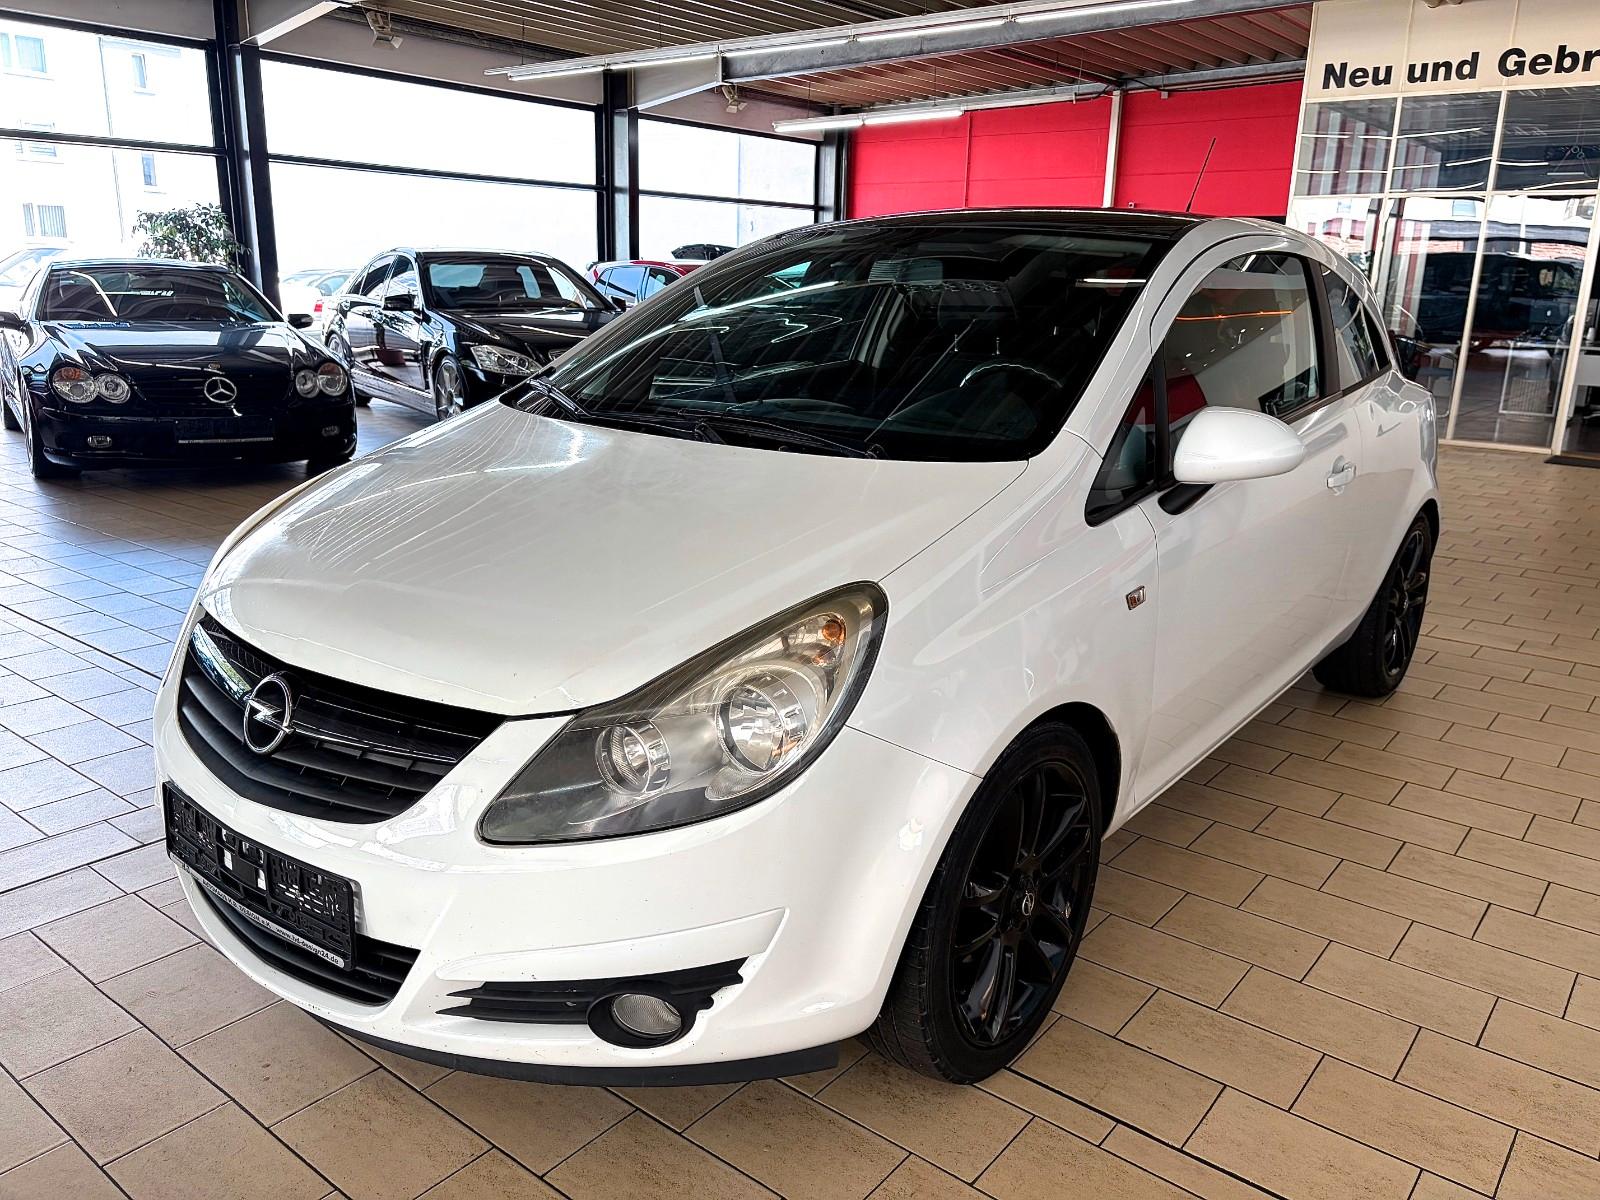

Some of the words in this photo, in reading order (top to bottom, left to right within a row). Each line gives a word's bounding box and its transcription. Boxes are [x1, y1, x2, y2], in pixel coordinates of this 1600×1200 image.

[1322, 62, 1393, 90] Neu
[1406, 51, 1480, 84] und
[1497, 44, 1600, 78] Gebr
